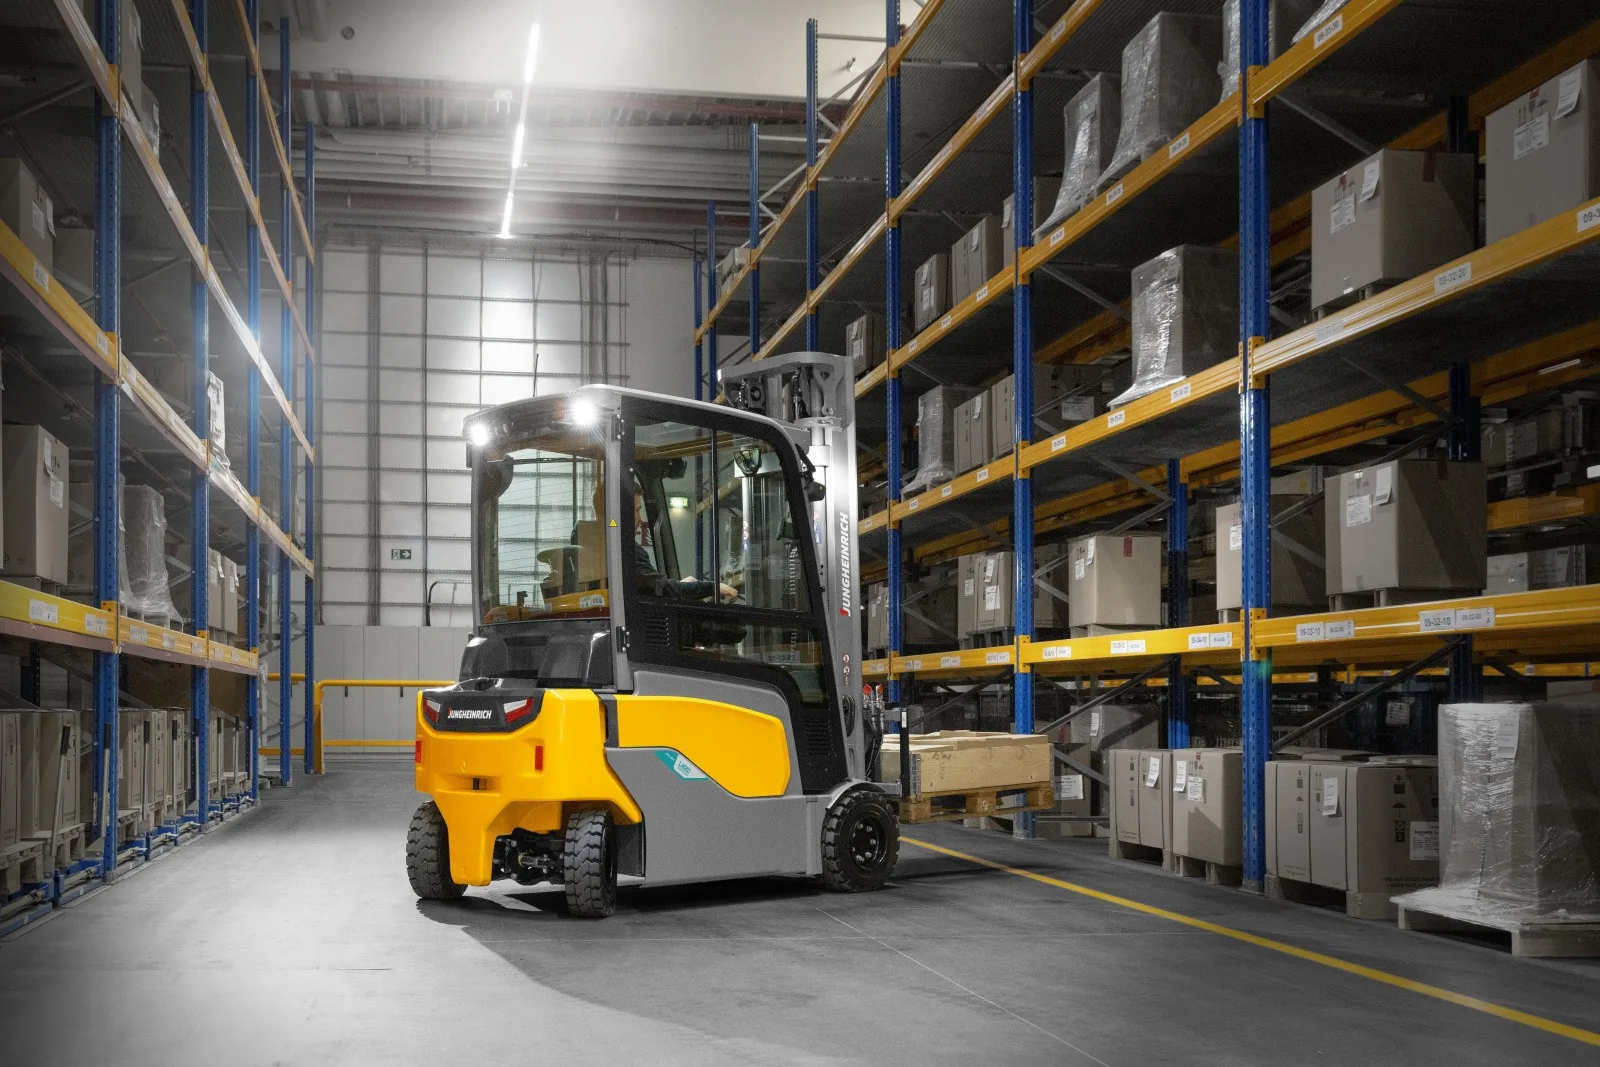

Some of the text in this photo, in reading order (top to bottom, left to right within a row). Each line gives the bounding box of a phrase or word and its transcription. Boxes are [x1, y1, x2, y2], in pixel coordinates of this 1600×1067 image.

[840, 512, 850, 617] JUNGHEINRICH
[1424, 617, 1451, 627] 09-32-10
[448, 707, 492, 719] JUNGHEINRICH
